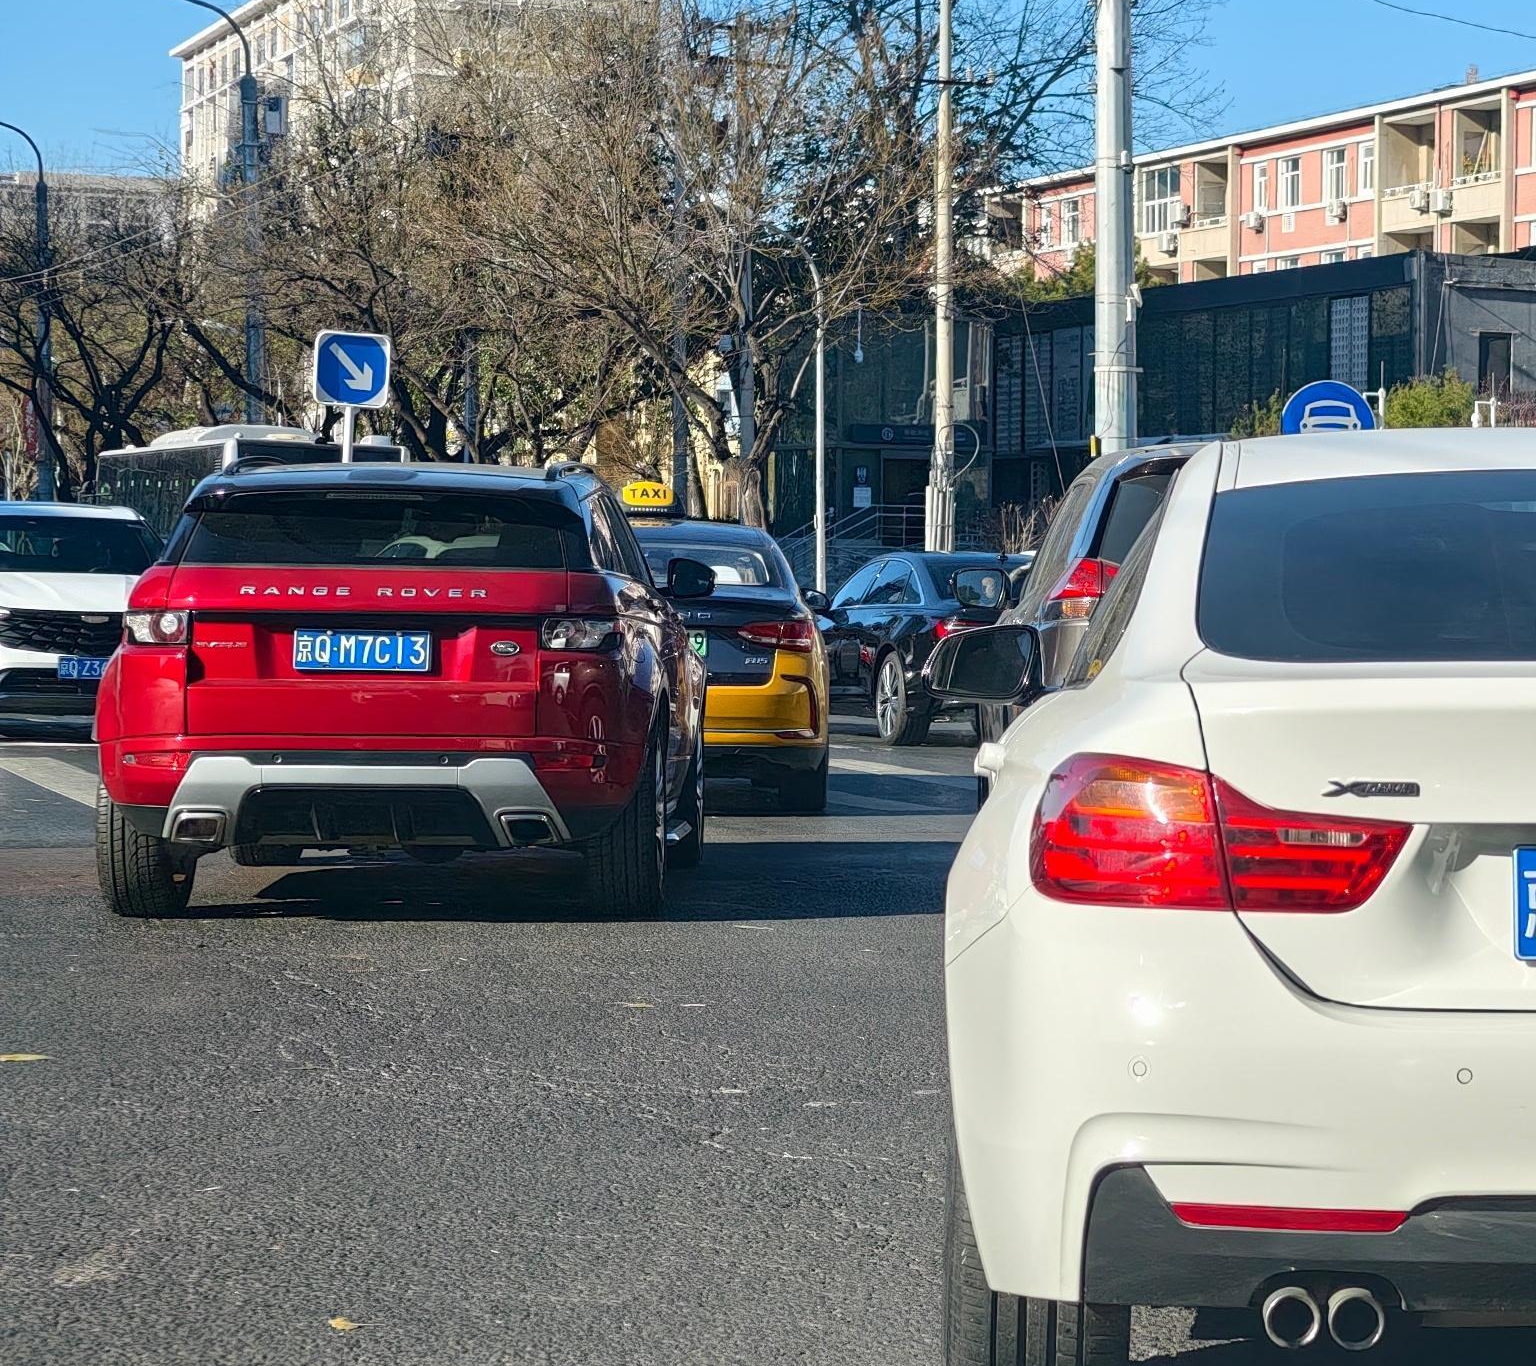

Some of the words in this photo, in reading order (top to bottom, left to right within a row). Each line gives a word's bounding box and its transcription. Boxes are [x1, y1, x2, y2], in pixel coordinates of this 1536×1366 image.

[630, 488, 667, 499] TAXI
[239, 586, 351, 596] RANGE
[377, 588, 488, 598] ROVER
